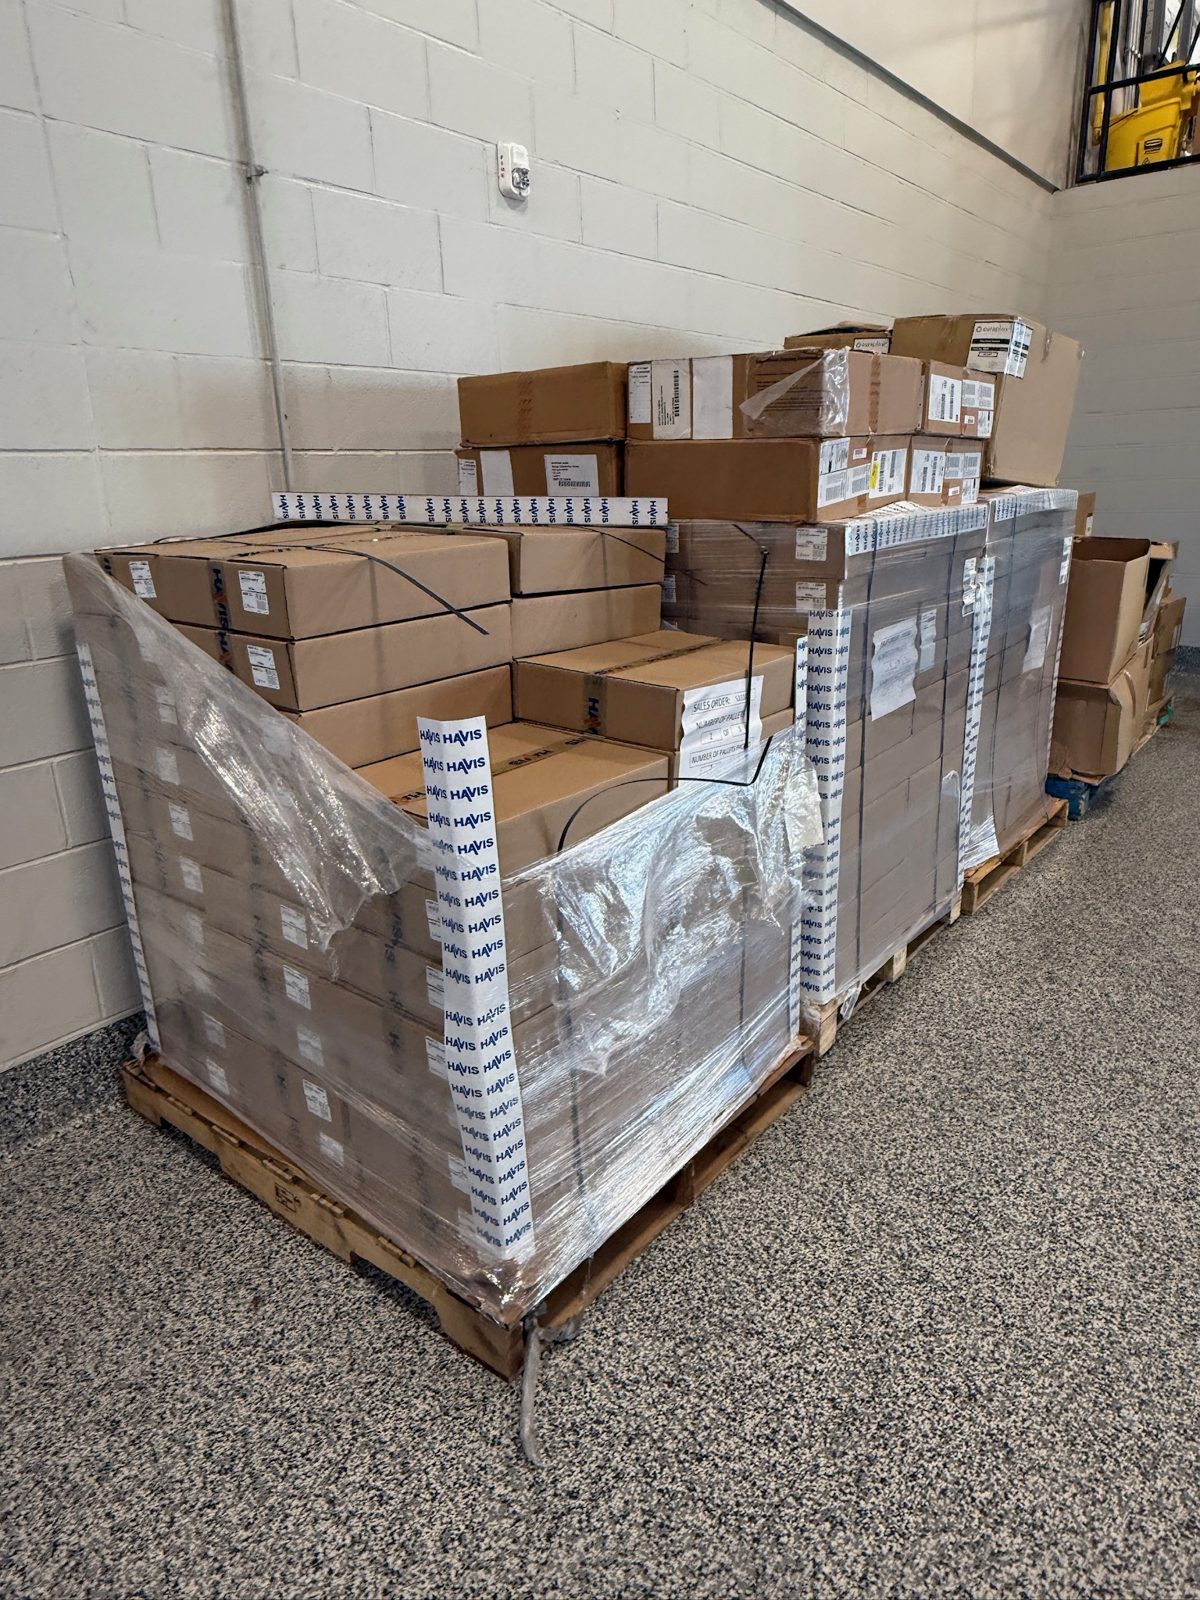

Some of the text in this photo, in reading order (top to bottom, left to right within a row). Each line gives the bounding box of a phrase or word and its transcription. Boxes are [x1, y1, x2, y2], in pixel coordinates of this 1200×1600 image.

[279, 494, 290, 519] HAVIS
[296, 494, 306, 519] HAVIS
[312, 495, 322, 520] HAVIS
[329, 495, 340, 520] HAVIS
[346, 495, 356, 520] HAVIS
[362, 495, 372, 520] HAVIS
[379, 496, 390, 520] HAVIS
[396, 496, 406, 520] HAVIS
[425, 498, 435, 523] HAVIS
[442, 498, 452, 523] HAVIS
[459, 499, 470, 524] HAVIS
[476, 500, 486, 524] HAVIS
[494, 499, 504, 524] HAVIS
[511, 499, 522, 524] HAVIS
[528, 499, 539, 524] HAVIS
[546, 498, 556, 523] HAVIS
[564, 499, 574, 524] HAVIS
[582, 499, 592, 524] HAVIS
[599, 498, 610, 524] HAVIS
[629, 500, 640, 525] HAVIS
[647, 500, 658, 525] HAVIS
[810, 610, 834, 620] HAVIS
[809, 628, 832, 639] HAVIS
[808, 646, 832, 657] HAVIS
[808, 664, 832, 676] HAVIS
[808, 684, 832, 694] HAVIS
[694, 700, 710, 712] SALES
[807, 702, 831, 712] HAVIS
[807, 720, 830, 730] HAVIS
[420, 729, 482, 746] HAVIS HAVIS
[806, 737, 830, 748] HAVIS
[424, 757, 486, 774] HAVIS HAVIS
[692, 752, 712, 764] NUMBER
[713, 750, 720, 758] OF
[427, 785, 447, 802] HAVIS
[450, 784, 489, 802] HAVIS
[430, 812, 492, 830] HAVIS HAVIS
[458, 838, 494, 856] HAVIS
[461, 864, 496, 882] HAVIS
[439, 889, 500, 908] HAVIS HAVIS
[442, 914, 502, 934] HAVIS HAVIS
[444, 939, 504, 959] HAVIS HAVIS
[446, 963, 506, 985] HAVIS HAVIS
[446, 1010, 474, 1027] HAVIS
[446, 1026, 509, 1052] HAVIS HAVIS
[448, 1050, 512, 1077] HAVIS HAVIS
[451, 1072, 516, 1099] HAVIS HAVIS
[456, 1096, 518, 1120] HAVIS HAVIS
[461, 1118, 522, 1142] HAVIS HAVIS
[465, 1139, 524, 1164] HAVIS HAVIS
[468, 1160, 526, 1185] HAVIS HAVIS
[471, 1181, 528, 1206] HAVIS HAVIS
[474, 1202, 530, 1227] HAVIS HAVIS
[506, 1221, 532, 1246] HAVIS
